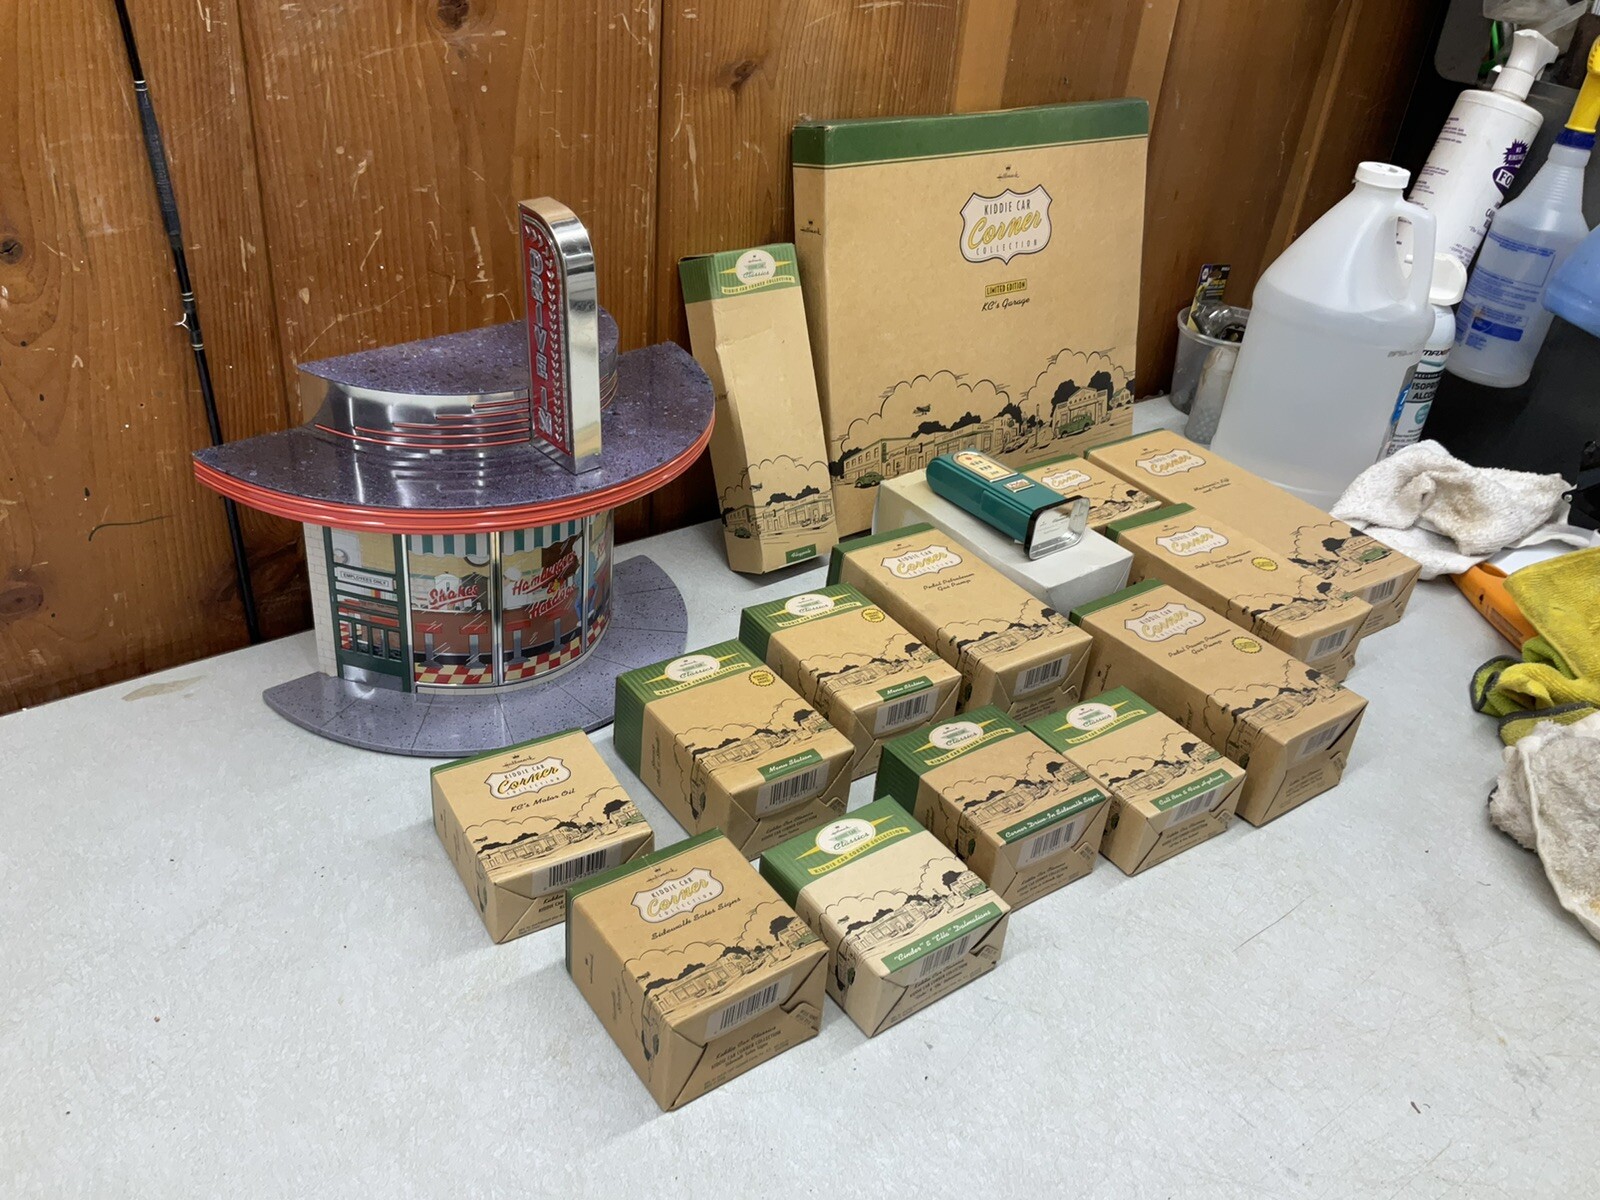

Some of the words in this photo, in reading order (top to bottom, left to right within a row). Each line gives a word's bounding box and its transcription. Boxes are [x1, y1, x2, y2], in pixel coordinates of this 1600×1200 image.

[984, 201, 1012, 215] KIDDIE
[1016, 199, 1031, 211] CAR
[968, 210, 1042, 250] Corner
[976, 239, 1037, 256] COLLECTION
[987, 284, 1006, 295] LIMITED
[1006, 280, 1025, 292] EDITION
[529, 247, 548, 380] DRIVE
[981, 300, 999, 312] KC's
[1002, 297, 1031, 310] Garage
[538, 386, 553, 436] IN
[1150, 454, 1192, 473] Corner
[1170, 532, 1214, 552] Corner
[896, 552, 948, 575] Corner
[897, 554, 920, 563] KIDDIE
[343, 573, 372, 583] EMPLOYEES
[923, 581, 942, 590] Pedal
[428, 584, 479, 606] Shakes
[1139, 613, 1160, 624] KIDDIE
[1160, 609, 1172, 617] CAR
[1141, 610, 1189, 638] Corner
[1191, 647, 1203, 655] Gas
[950, 749, 960, 757] CAR
[504, 768, 529, 780] KIDDIE
[532, 764, 545, 772] CAR
[769, 763, 788, 773] Menu
[788, 754, 812, 765] Station
[497, 766, 559, 795] Corner
[506, 777, 561, 796] COLLECTION
[510, 803, 530, 813] KC's
[532, 795, 559, 807] Motor
[561, 788, 576, 796] Oil
[1005, 826, 1028, 838] Corner
[1027, 813, 1056, 828] Drive-In
[1056, 800, 1083, 815] Sidewalk
[1083, 793, 1100, 804] Signs
[814, 861, 836, 874] KIDDIE
[837, 855, 848, 864] CAR
[849, 842, 870, 857] CORNER
[871, 828, 905, 845] COLLECTION
[833, 832, 870, 851] Classics
[647, 878, 709, 917] Corner
[651, 884, 677, 898] KIDDIE
[679, 877, 693, 887] CAR
[658, 891, 714, 918] COLLECTION
[651, 918, 692, 940] Sidewalk
[693, 909, 716, 921] Sales
[717, 897, 741, 911] Signs
[953, 910, 991, 932] Dalmatians
